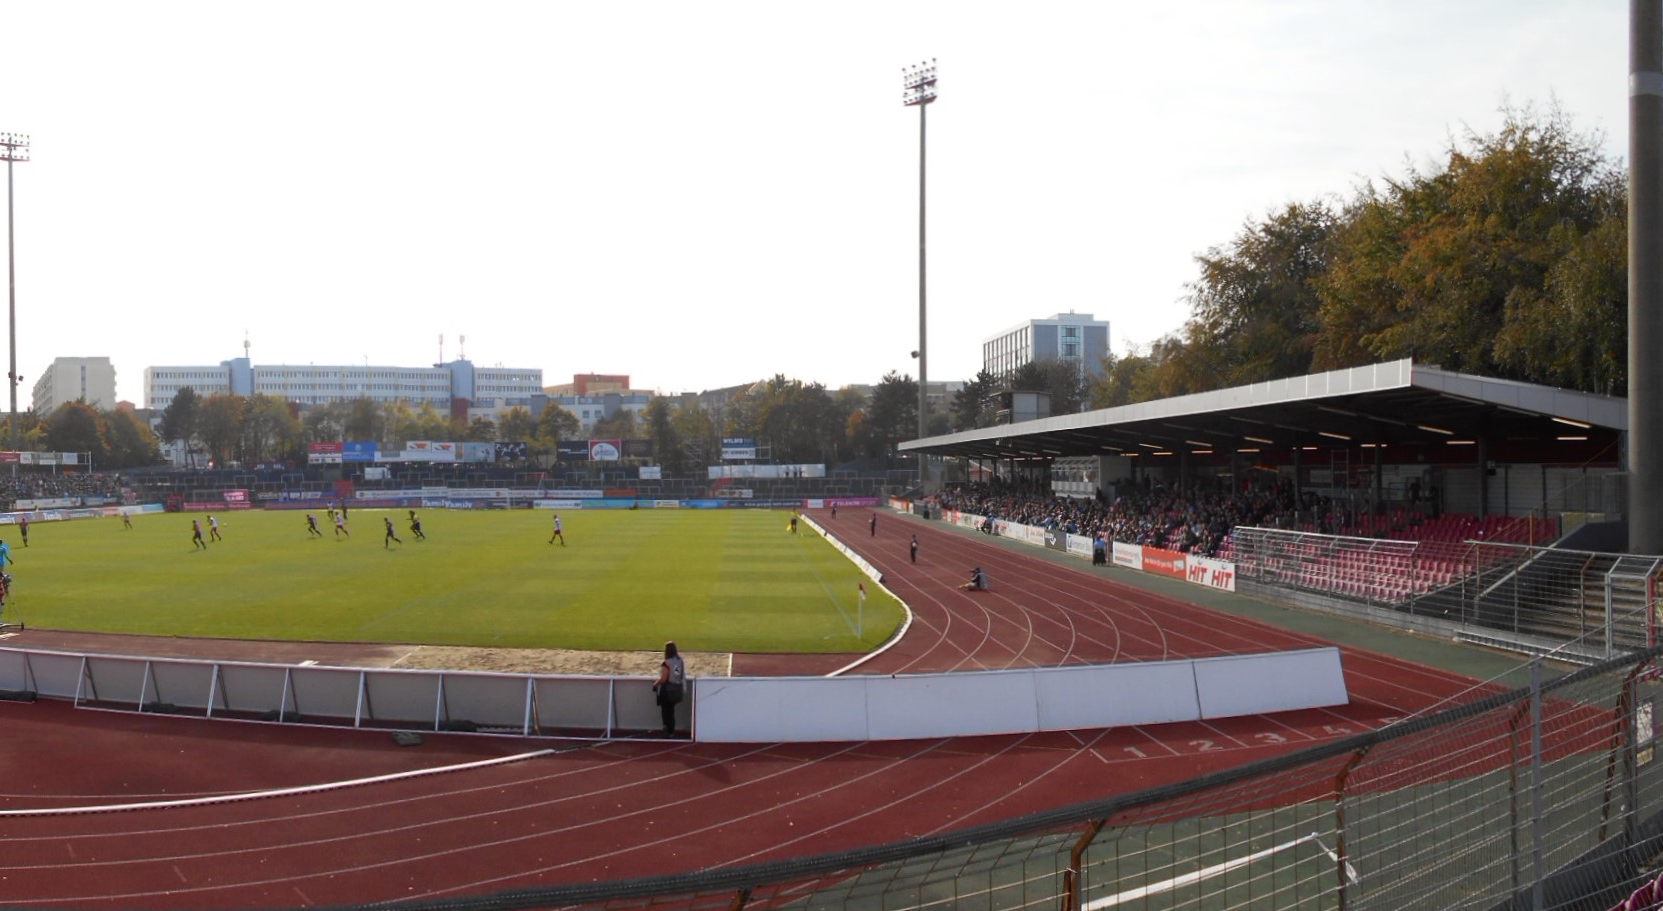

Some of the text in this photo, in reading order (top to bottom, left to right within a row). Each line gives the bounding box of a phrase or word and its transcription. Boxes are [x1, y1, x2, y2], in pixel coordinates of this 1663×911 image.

[1188, 565, 1232, 588] HIT HIT
[1254, 732, 1287, 744] 3
[1189, 739, 1224, 752] 2
[1123, 746, 1148, 758] 1
